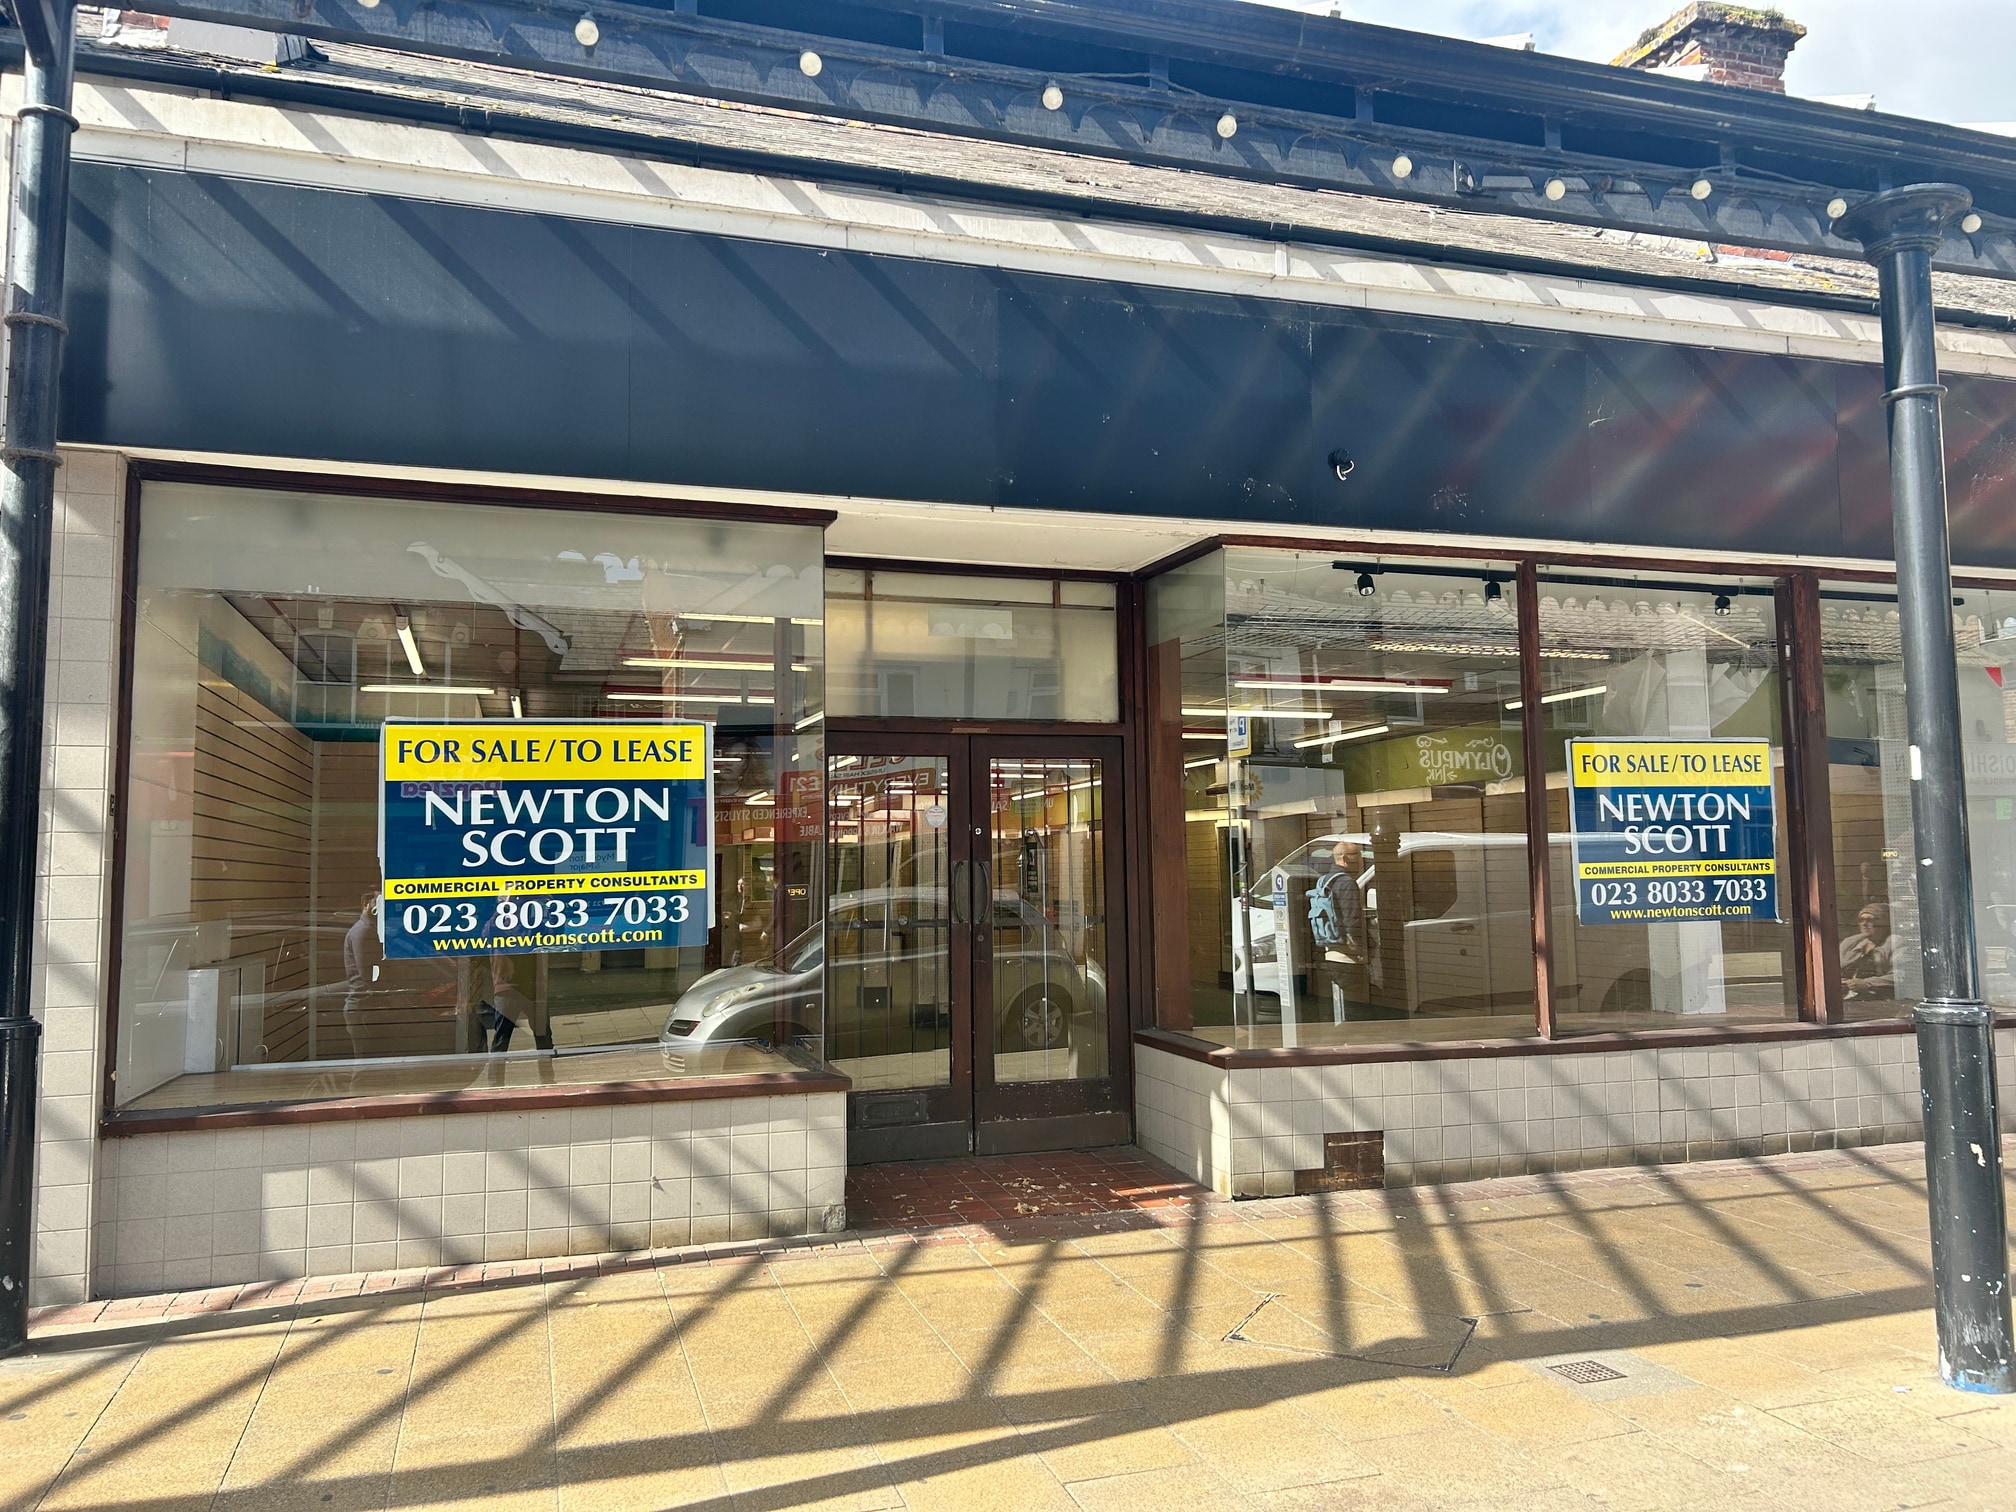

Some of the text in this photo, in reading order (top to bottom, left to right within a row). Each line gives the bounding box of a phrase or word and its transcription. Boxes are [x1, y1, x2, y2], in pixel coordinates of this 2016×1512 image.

[398, 740, 459, 763] FOR
[613, 740, 692, 762] LEASE
[1581, 755, 1621, 773] FOR
[1713, 754, 1762, 772] LEASE
[424, 787, 670, 826] NEWTON
[1599, 793, 1751, 822] NEWTON
[461, 827, 636, 868] SCOTT
[1624, 824, 1731, 854] SCOTT
[1584, 862, 1771, 875] COMMERCIAL PROPERTY CONSULTANTS
[393, 874, 698, 895] COMMERCIAL PROPERTY CONSULTANTS
[1591, 878, 1767, 906] 023 8033 7033
[403, 894, 690, 935] 023 8033 7033
[1610, 904, 1751, 920] www.newtonscott.com
[432, 926, 663, 951] www.newtonscott.com
